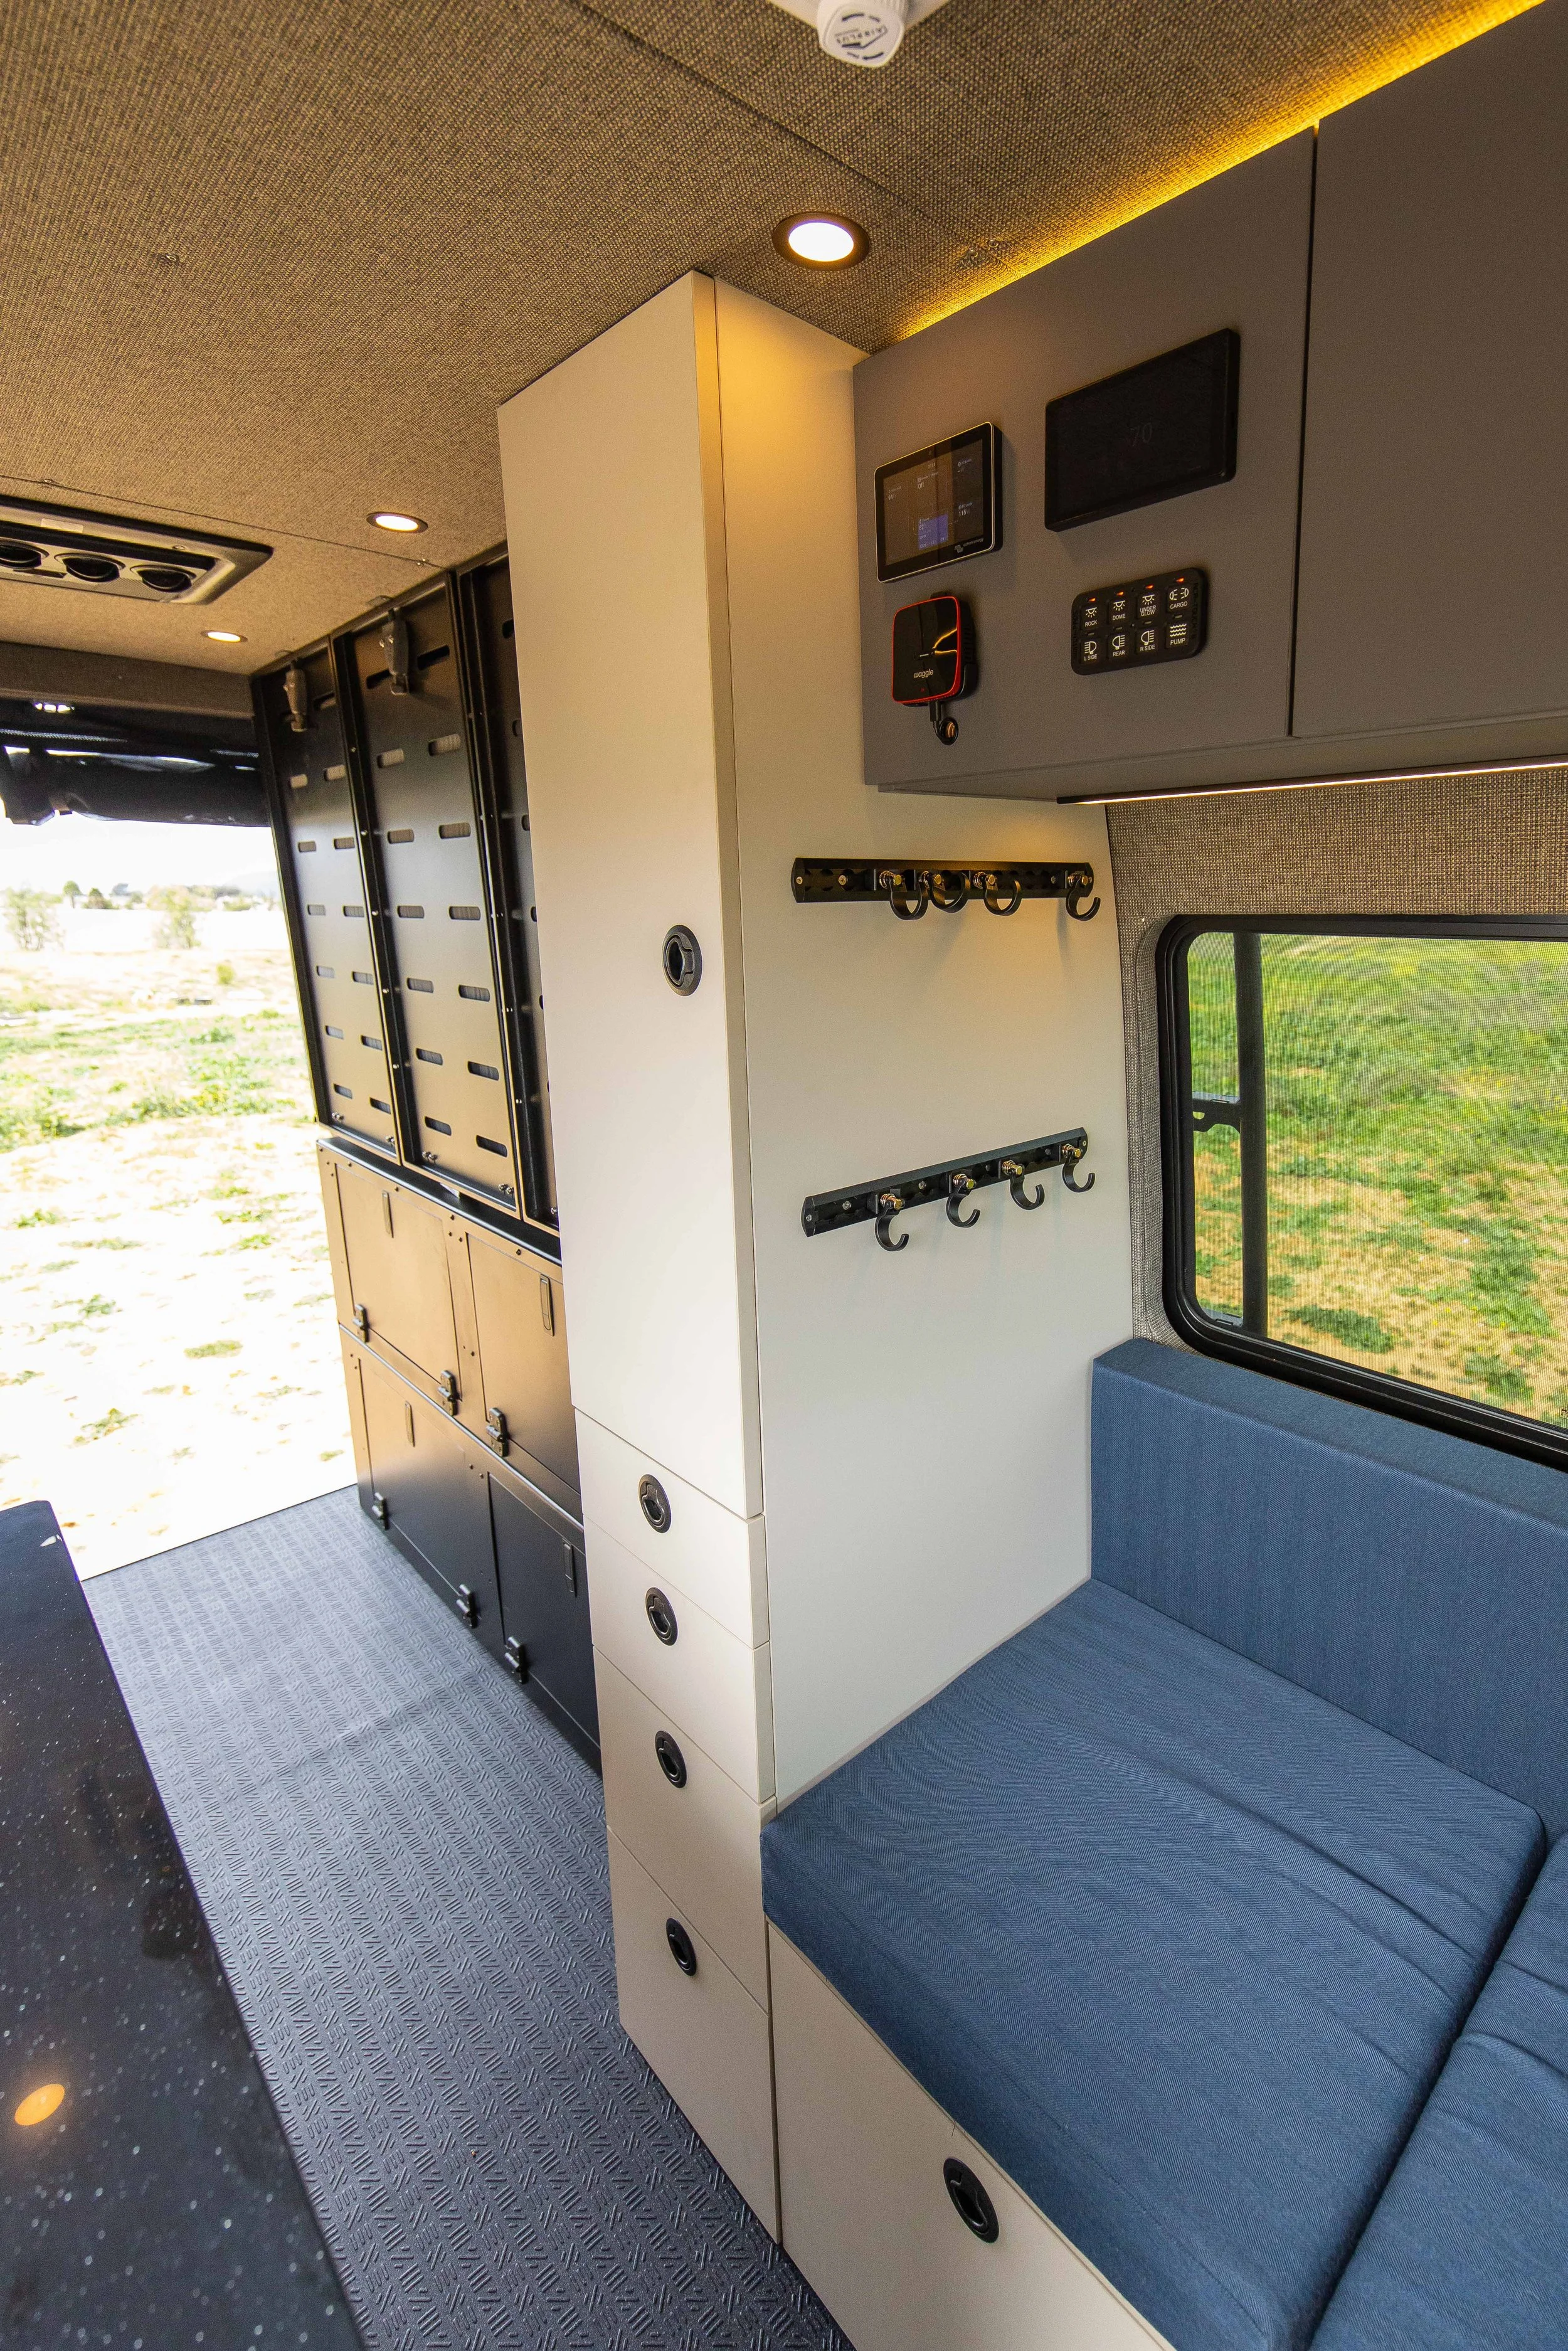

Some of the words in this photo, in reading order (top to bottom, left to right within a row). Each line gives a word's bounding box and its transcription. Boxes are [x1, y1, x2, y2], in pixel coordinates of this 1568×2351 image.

[1170, 601, 1188, 609] CARGO
[1170, 637, 1186, 645] PUMP
[913, 668, 934, 678] waggle
